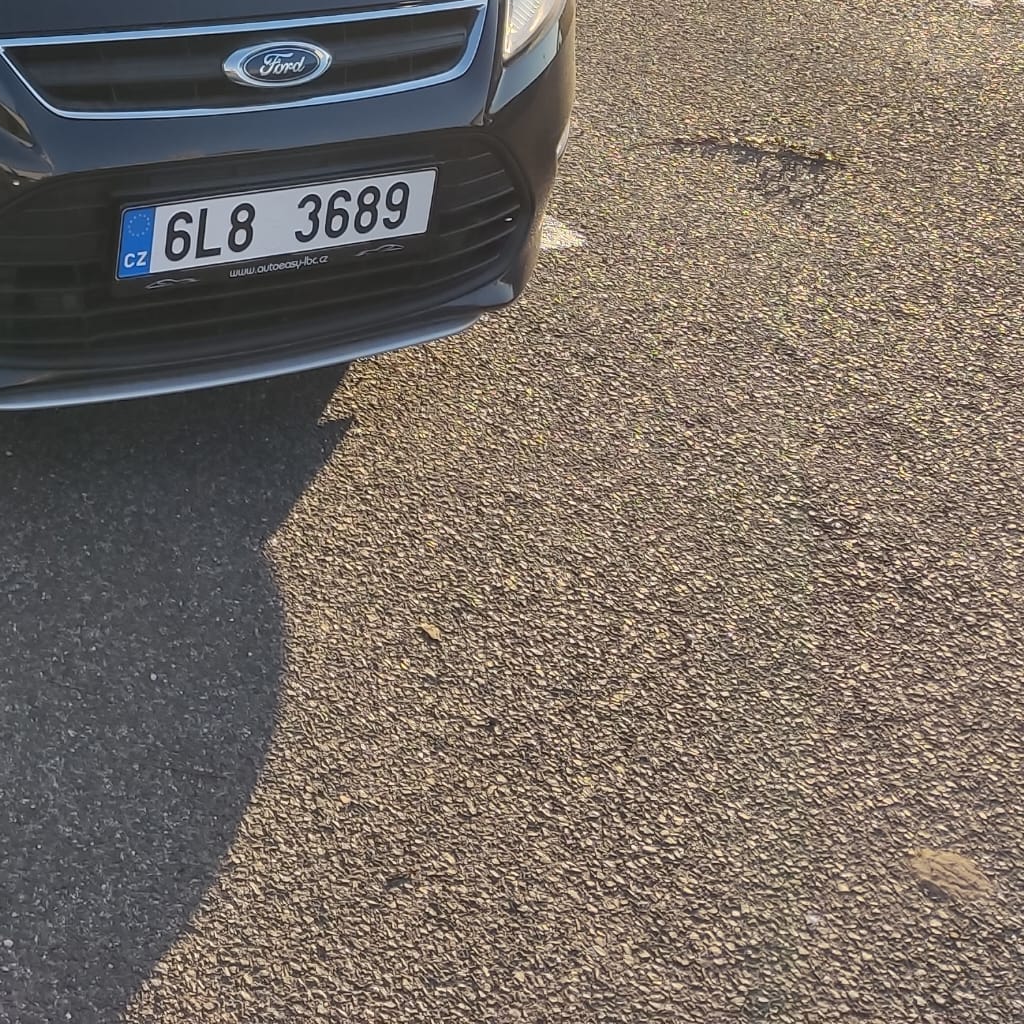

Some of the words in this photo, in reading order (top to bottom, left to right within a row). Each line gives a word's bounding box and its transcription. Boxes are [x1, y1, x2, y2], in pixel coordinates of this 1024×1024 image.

[259, 52, 305, 76] Ford
[164, 202, 256, 262] 6L8
[294, 181, 410, 243] 3689
[124, 251, 147, 268] CZ
[229, 255, 329, 278] www.autoeasy-lbc.cz
